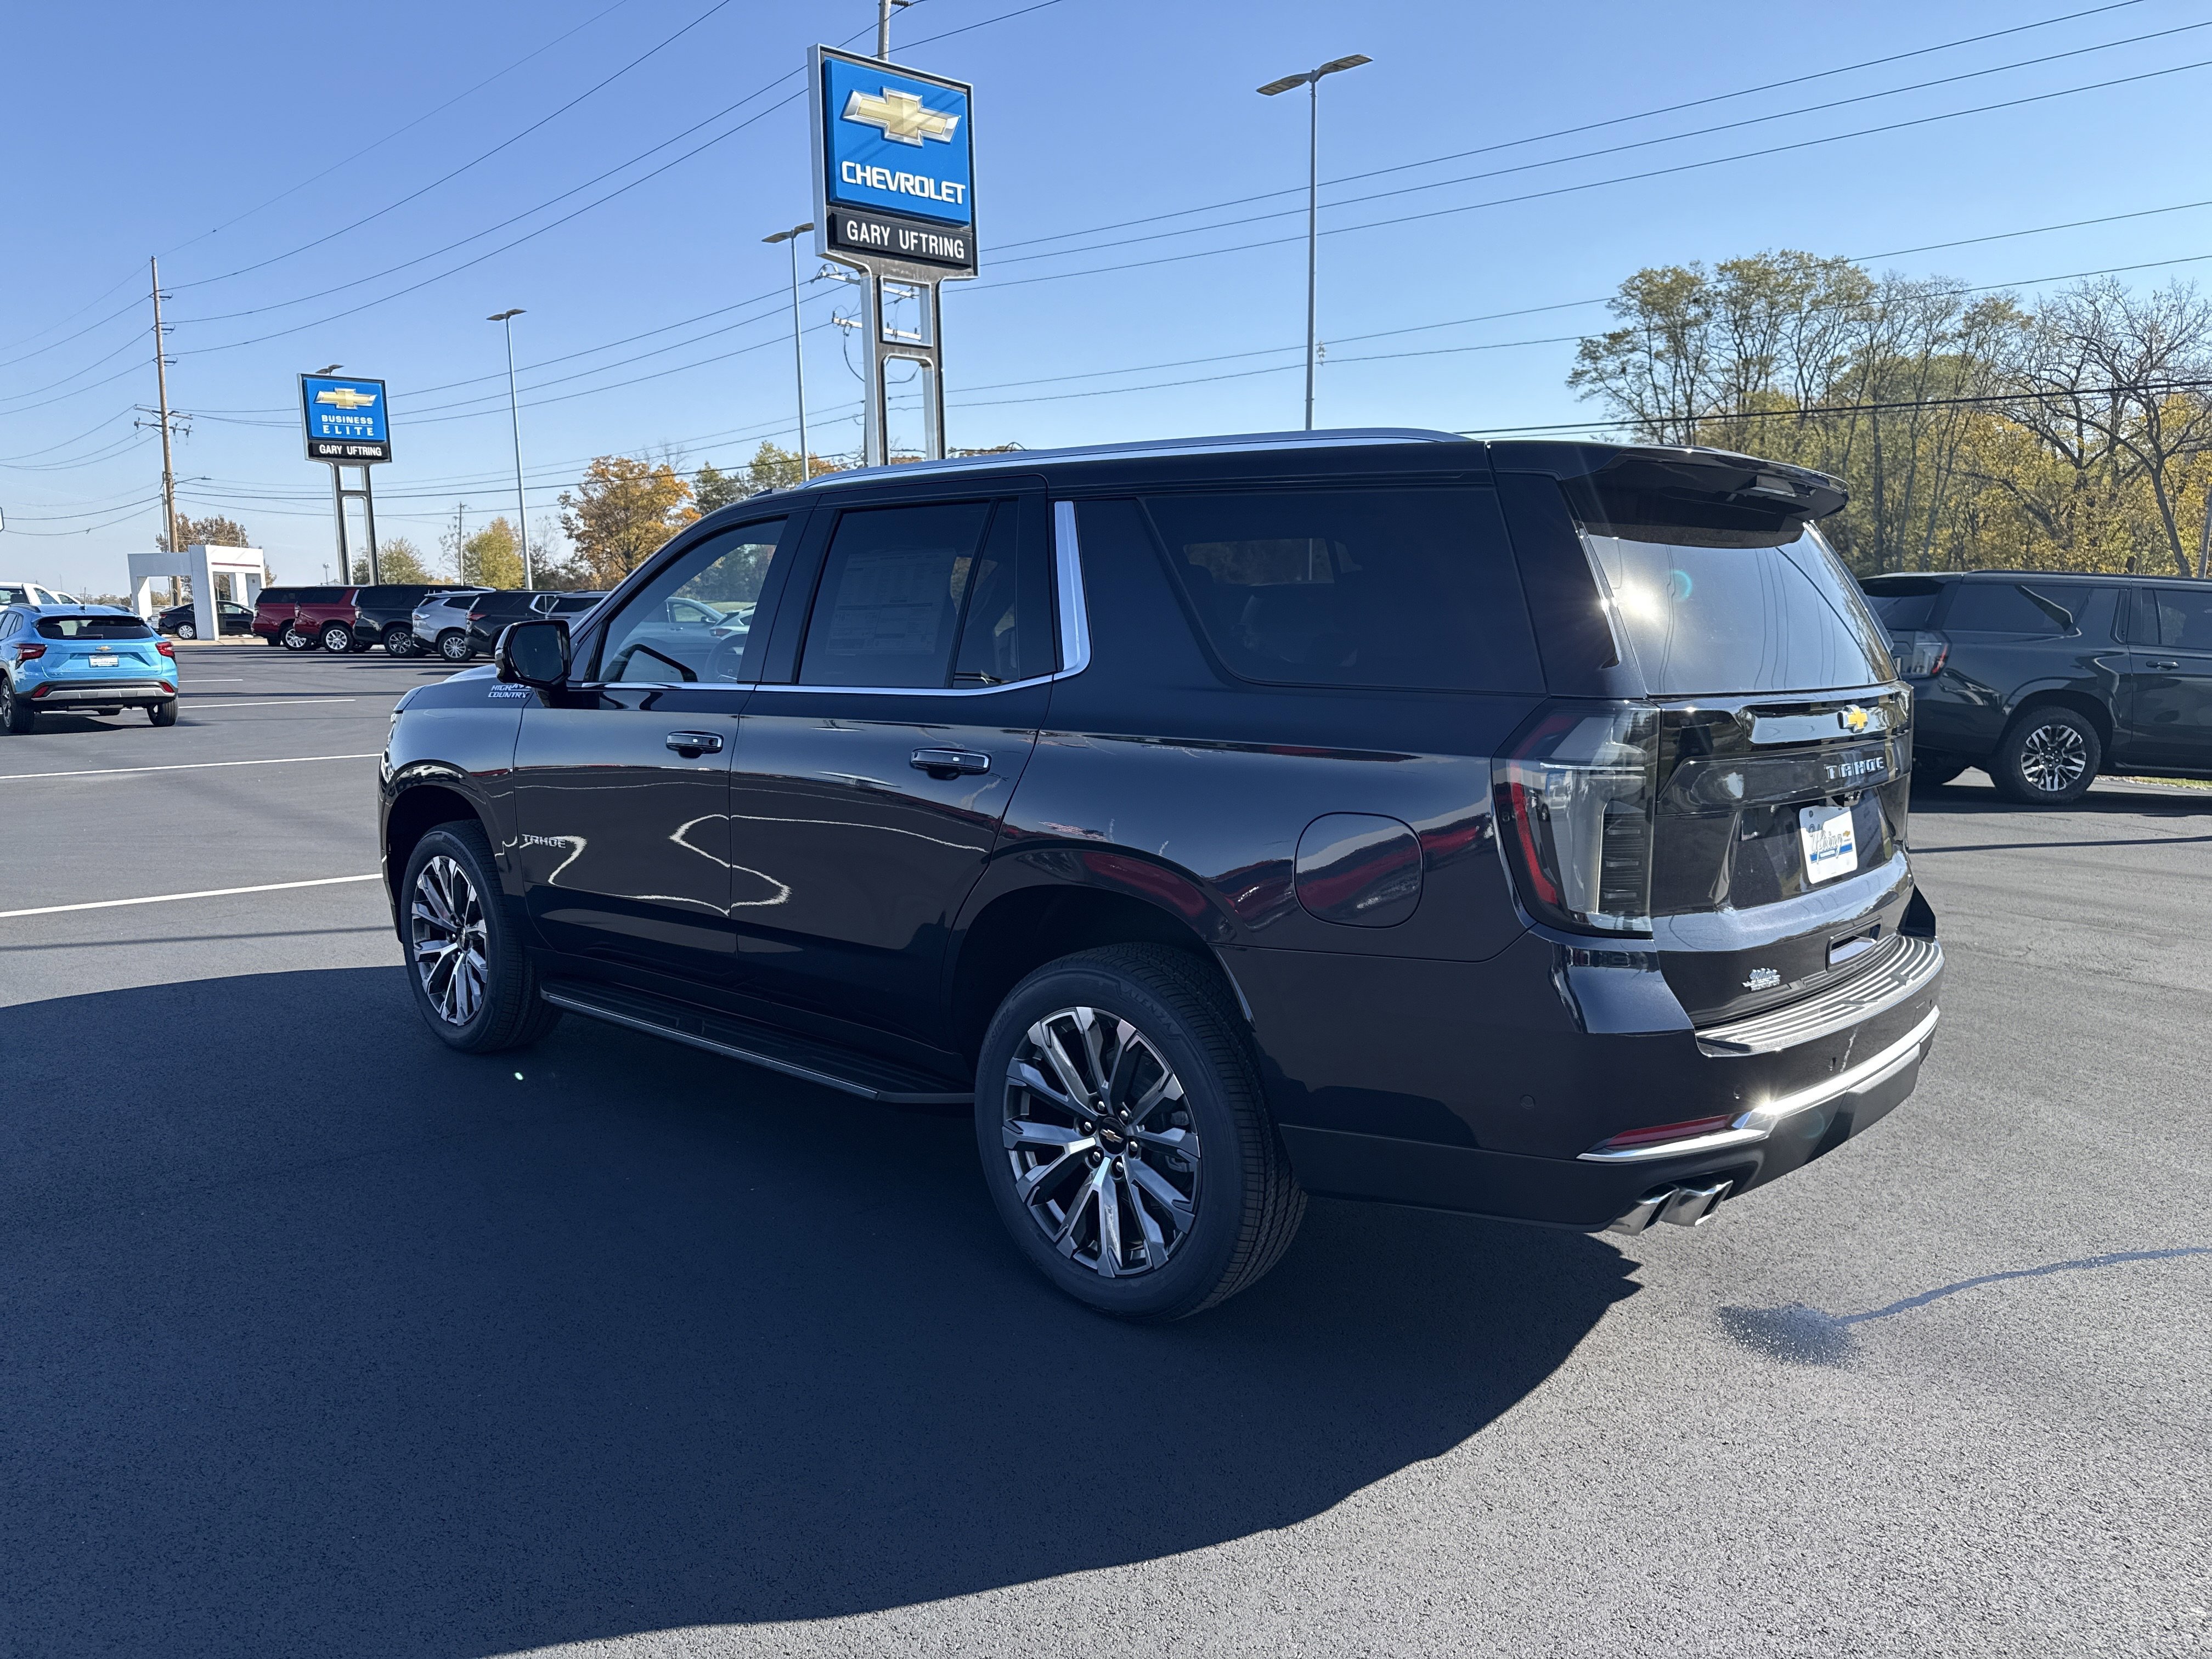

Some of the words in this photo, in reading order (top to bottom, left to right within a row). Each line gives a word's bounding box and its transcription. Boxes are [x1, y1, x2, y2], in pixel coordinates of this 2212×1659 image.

[841, 161, 966, 204] CHEVROLET
[847, 220, 890, 246] GARY
[898, 229, 964, 259] UFTRING
[321, 414, 374, 425] BUSINESS
[323, 425, 374, 436] ELITE
[319, 444, 342, 454] GARY
[346, 446, 382, 456] UFTRING
[1824, 757, 1885, 781] TAHOE
[441, 834, 473, 867] BRIDGESTONE
[522, 834, 566, 848] TAHOE
[1122, 989, 1173, 1030] ALENZA
[980, 1007, 1010, 1077] DGESTONE
